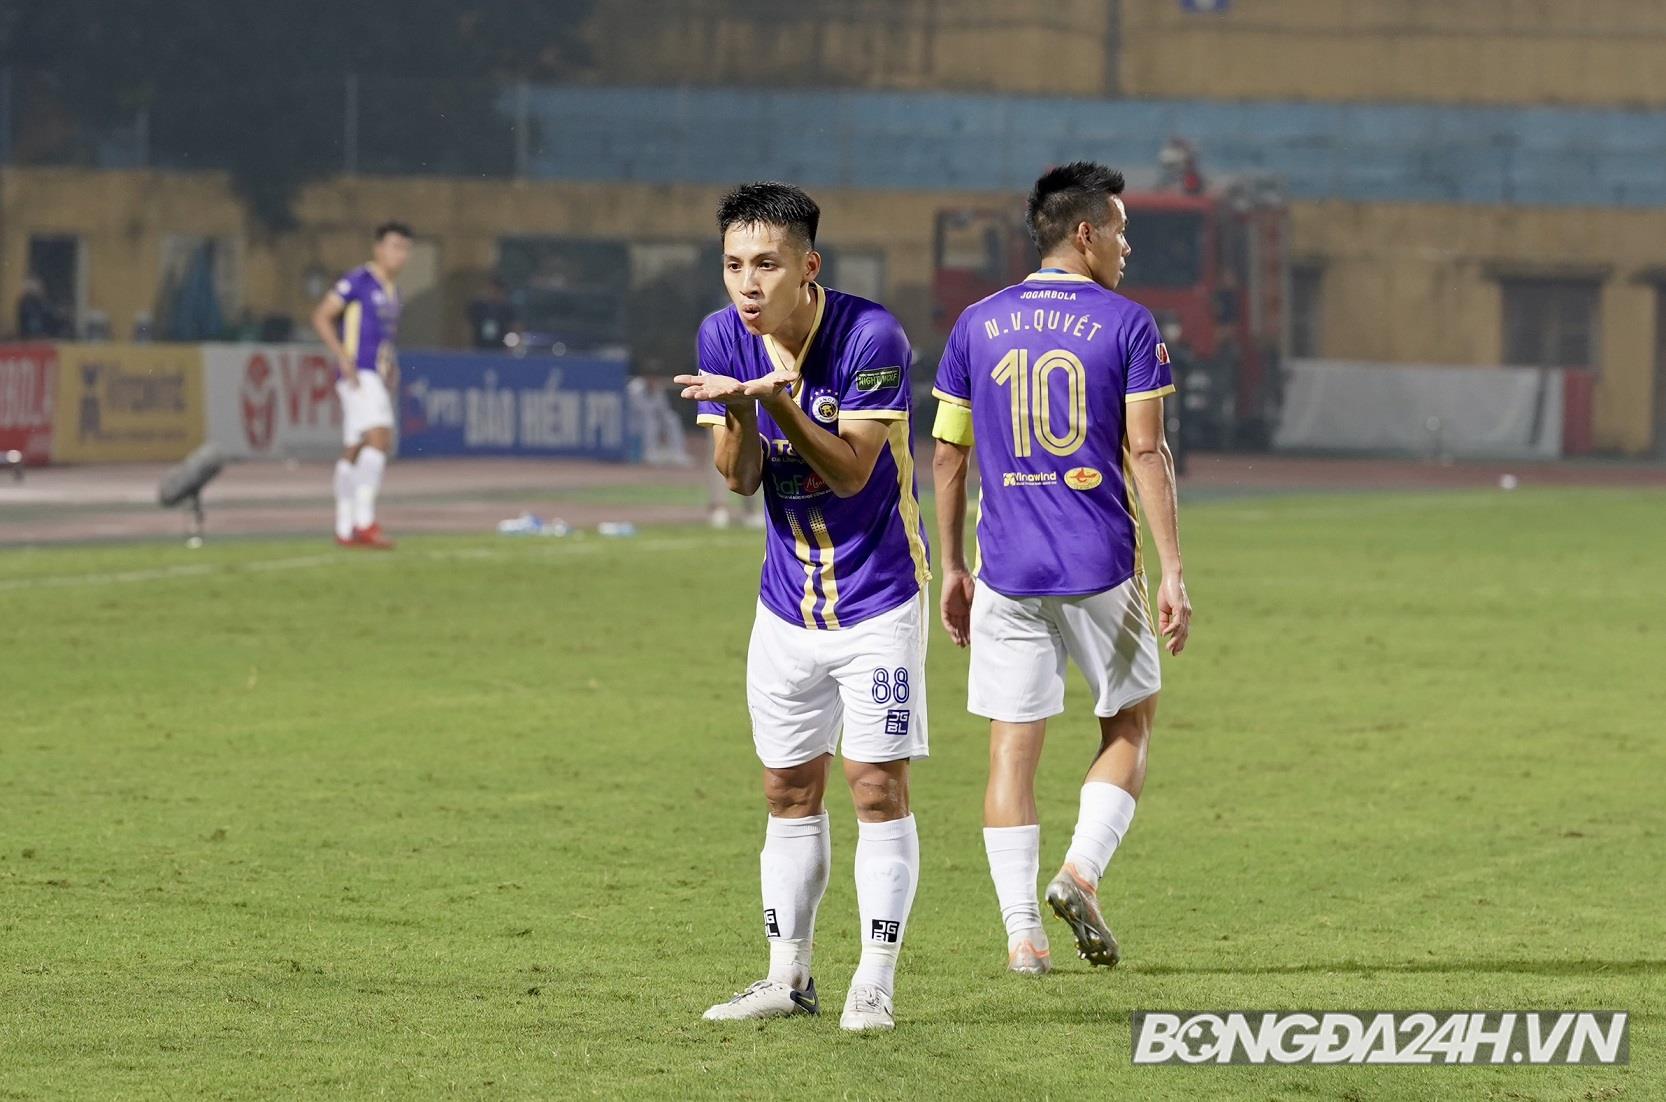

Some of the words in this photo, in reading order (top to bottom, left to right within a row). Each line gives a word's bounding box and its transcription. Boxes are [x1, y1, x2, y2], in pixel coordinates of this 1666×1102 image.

[1020, 290, 1076, 300] JOGARBOLA
[991, 348, 1087, 457] 10
[872, 667, 909, 704] 88
